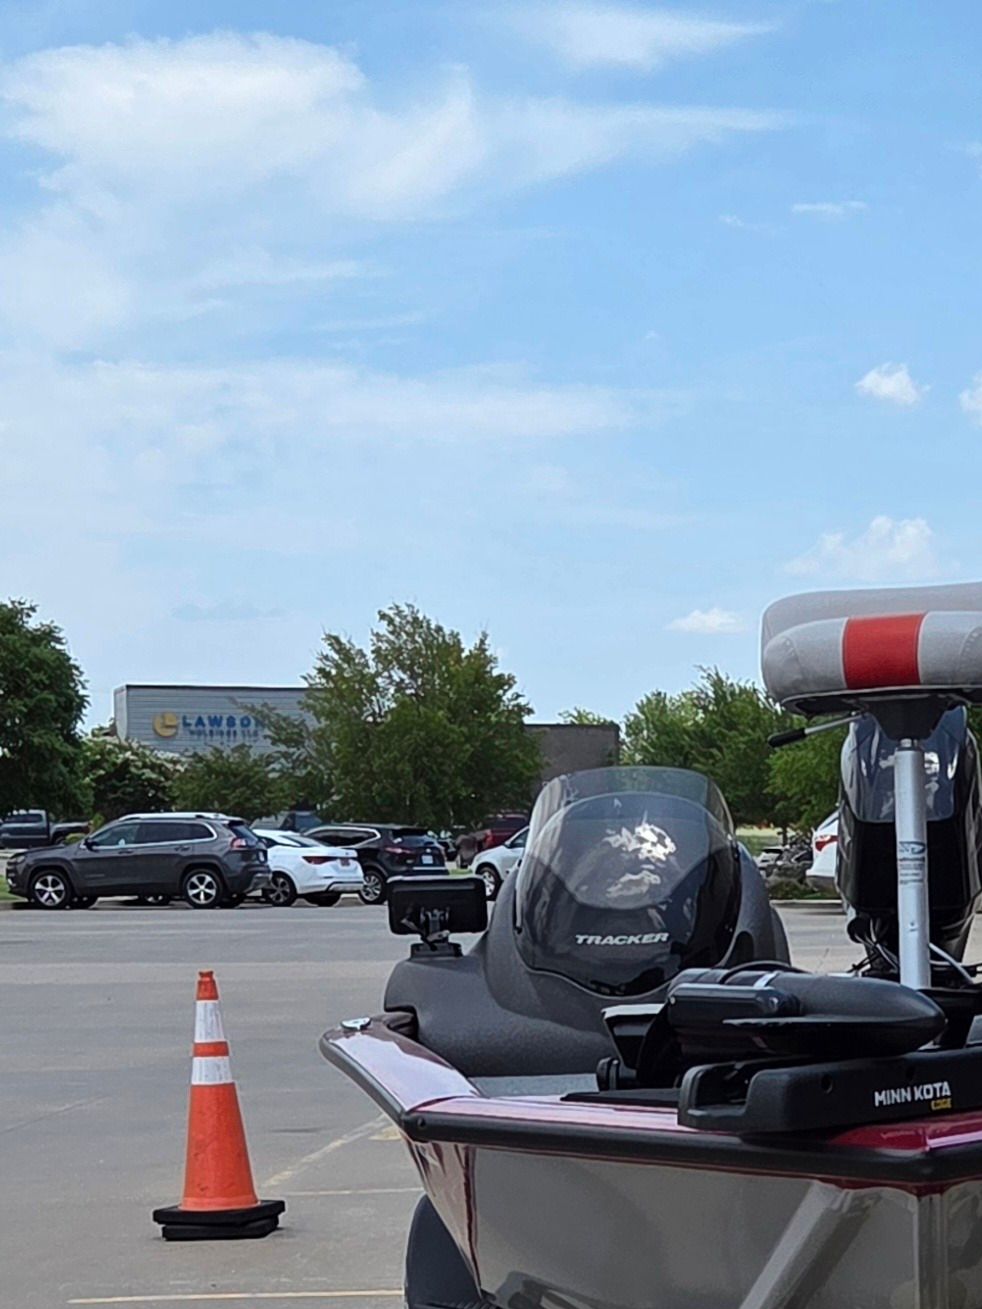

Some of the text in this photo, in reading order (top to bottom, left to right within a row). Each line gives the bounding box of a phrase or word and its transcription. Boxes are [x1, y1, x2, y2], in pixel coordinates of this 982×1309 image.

[182, 714, 265, 729] LAWSO
[575, 932, 670, 945] TRACKER
[874, 1086, 912, 1107] MINN
[913, 1080, 951, 1101] KOTA
